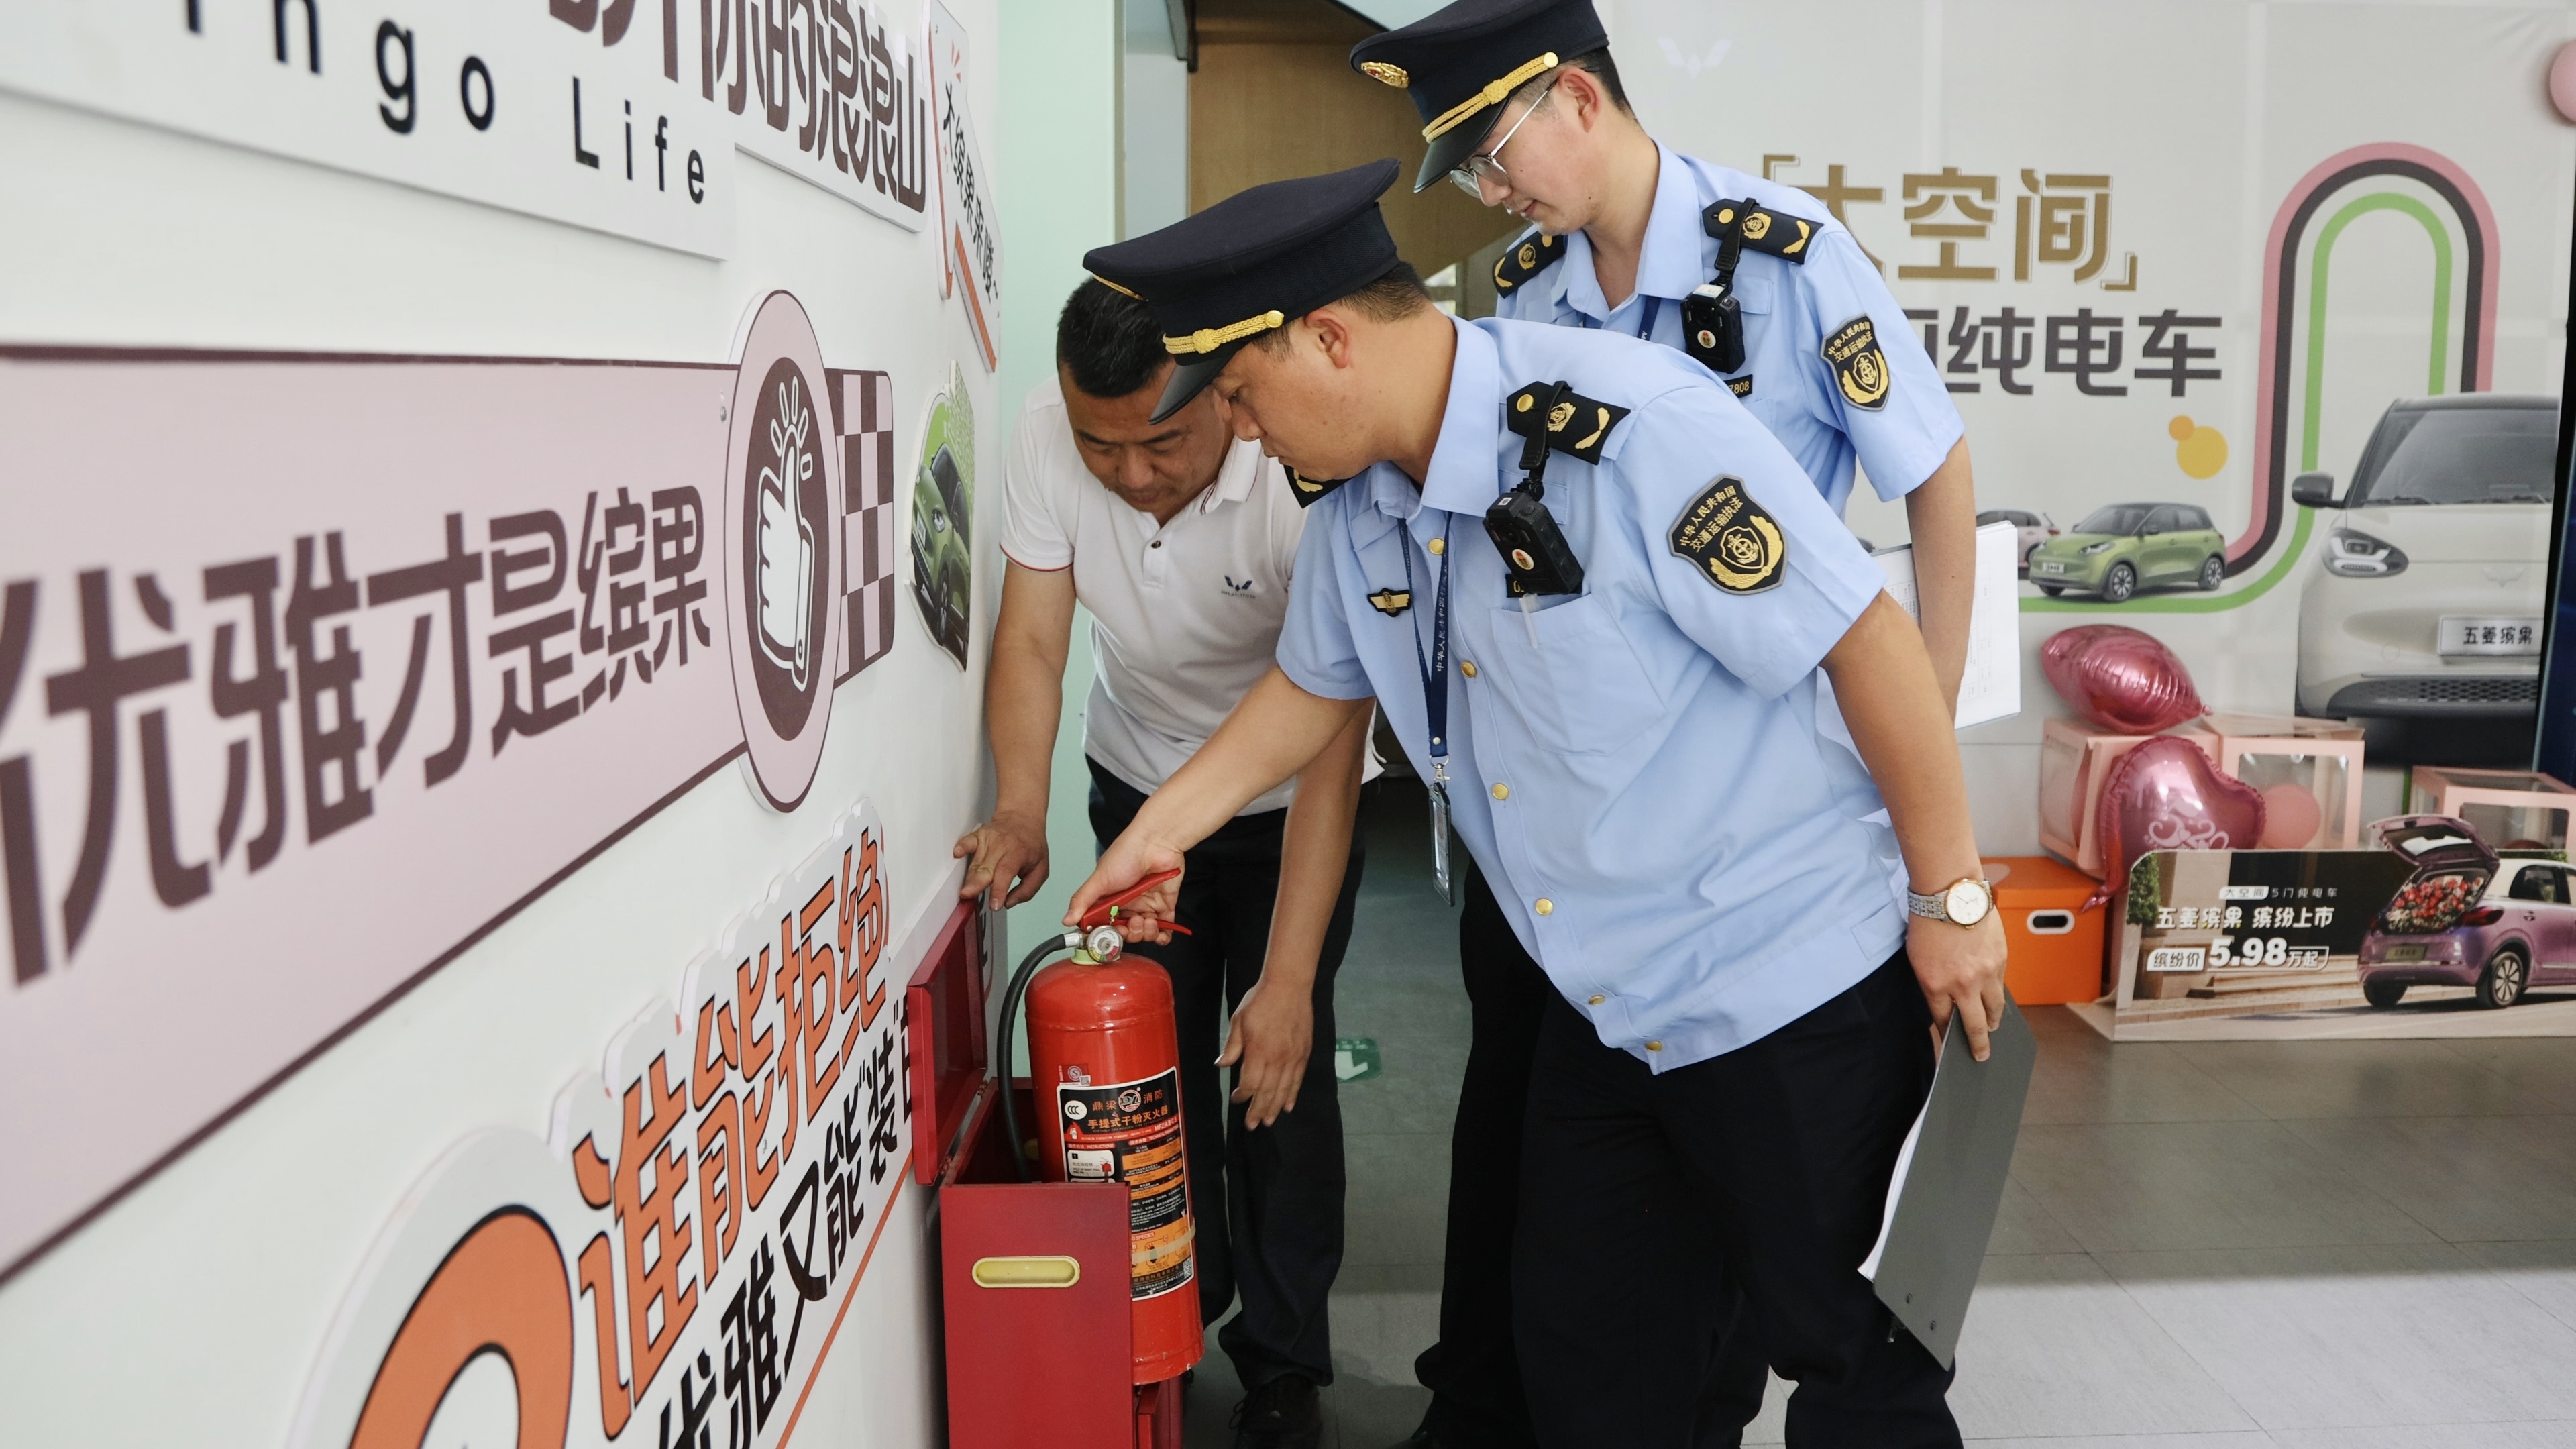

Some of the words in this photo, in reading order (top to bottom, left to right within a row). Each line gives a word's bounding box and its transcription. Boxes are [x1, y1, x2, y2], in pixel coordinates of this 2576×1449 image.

[572, 76, 705, 205] Life
[1679, 485, 1737, 547] 中华人民共和国
[1689, 496, 1744, 553] 交通运输执法
[2463, 626, 2533, 645] 五菱缤果
[0, 485, 710, 988] 优雅才是缤果
[2224, 887, 2265, 898] 大空间
[2156, 906, 2243, 929] 五菱缤果
[2251, 906, 2336, 929] 缤纷上市
[2153, 951, 2201, 968] 缤纷价
[2208, 936, 2288, 967] 5.98
[1143, 1089, 1163, 1104] 消防
[1087, 1105, 1168, 1130] 手提式干粉灭火器
[572, 826, 888, 1442] 谁能拒绝
